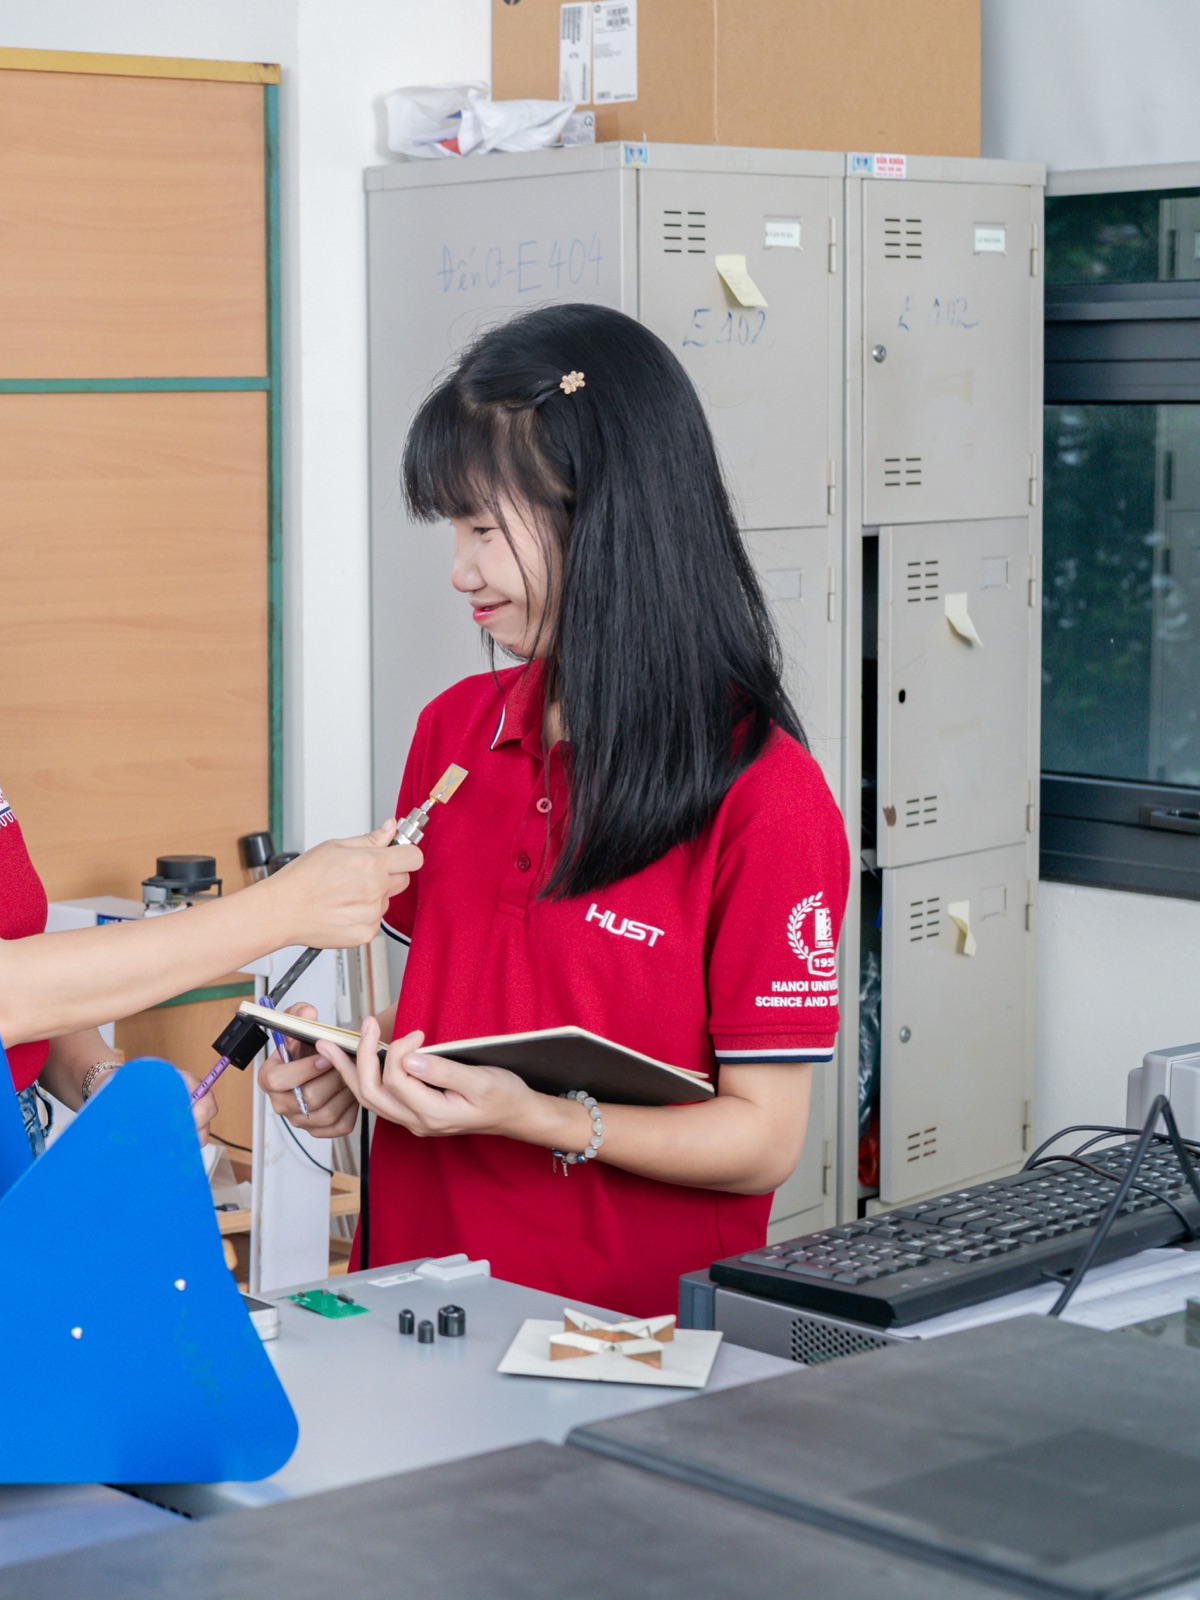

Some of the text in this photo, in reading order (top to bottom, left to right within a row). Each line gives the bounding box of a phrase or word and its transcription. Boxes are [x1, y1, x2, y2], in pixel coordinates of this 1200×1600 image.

[585, 903, 665, 947] HUST
[771, 980, 809, 992] HANOI
[755, 996, 802, 1007] SCIENCE
[804, 996, 828, 1007] AND
